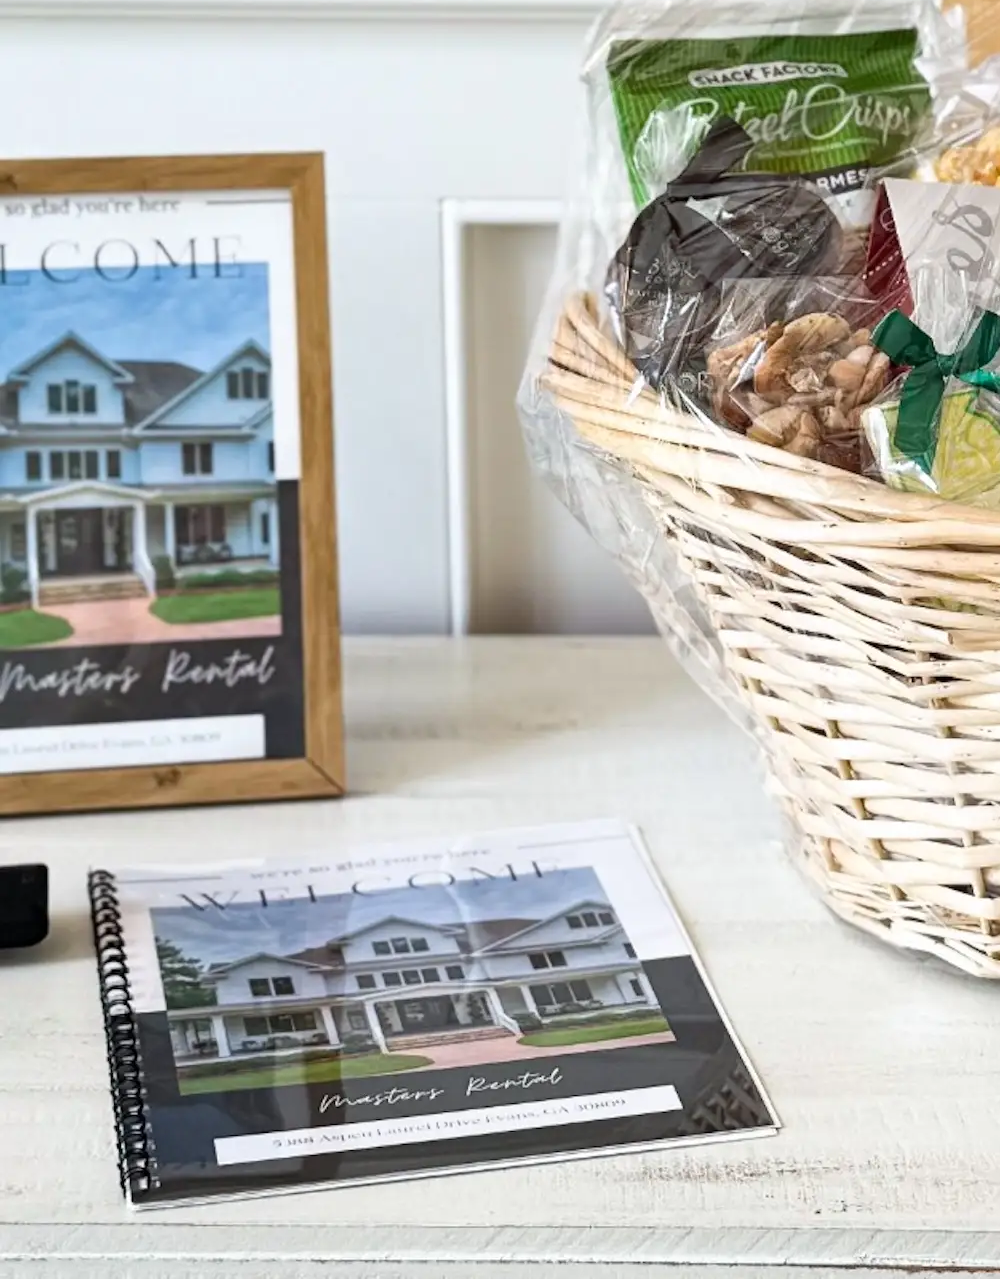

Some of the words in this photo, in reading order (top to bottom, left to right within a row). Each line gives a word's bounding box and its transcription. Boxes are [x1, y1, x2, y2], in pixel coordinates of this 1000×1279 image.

[694, 68, 757, 86] SNACK
[31, 197, 70, 219] glad
[139, 194, 181, 214] here
[0, 233, 245, 287] LCOME
[161, 644, 276, 694] Rental
[176, 858, 560, 912] WELCOME
[318, 1085, 446, 1115] Masters
[465, 1067, 564, 1098] Rental
